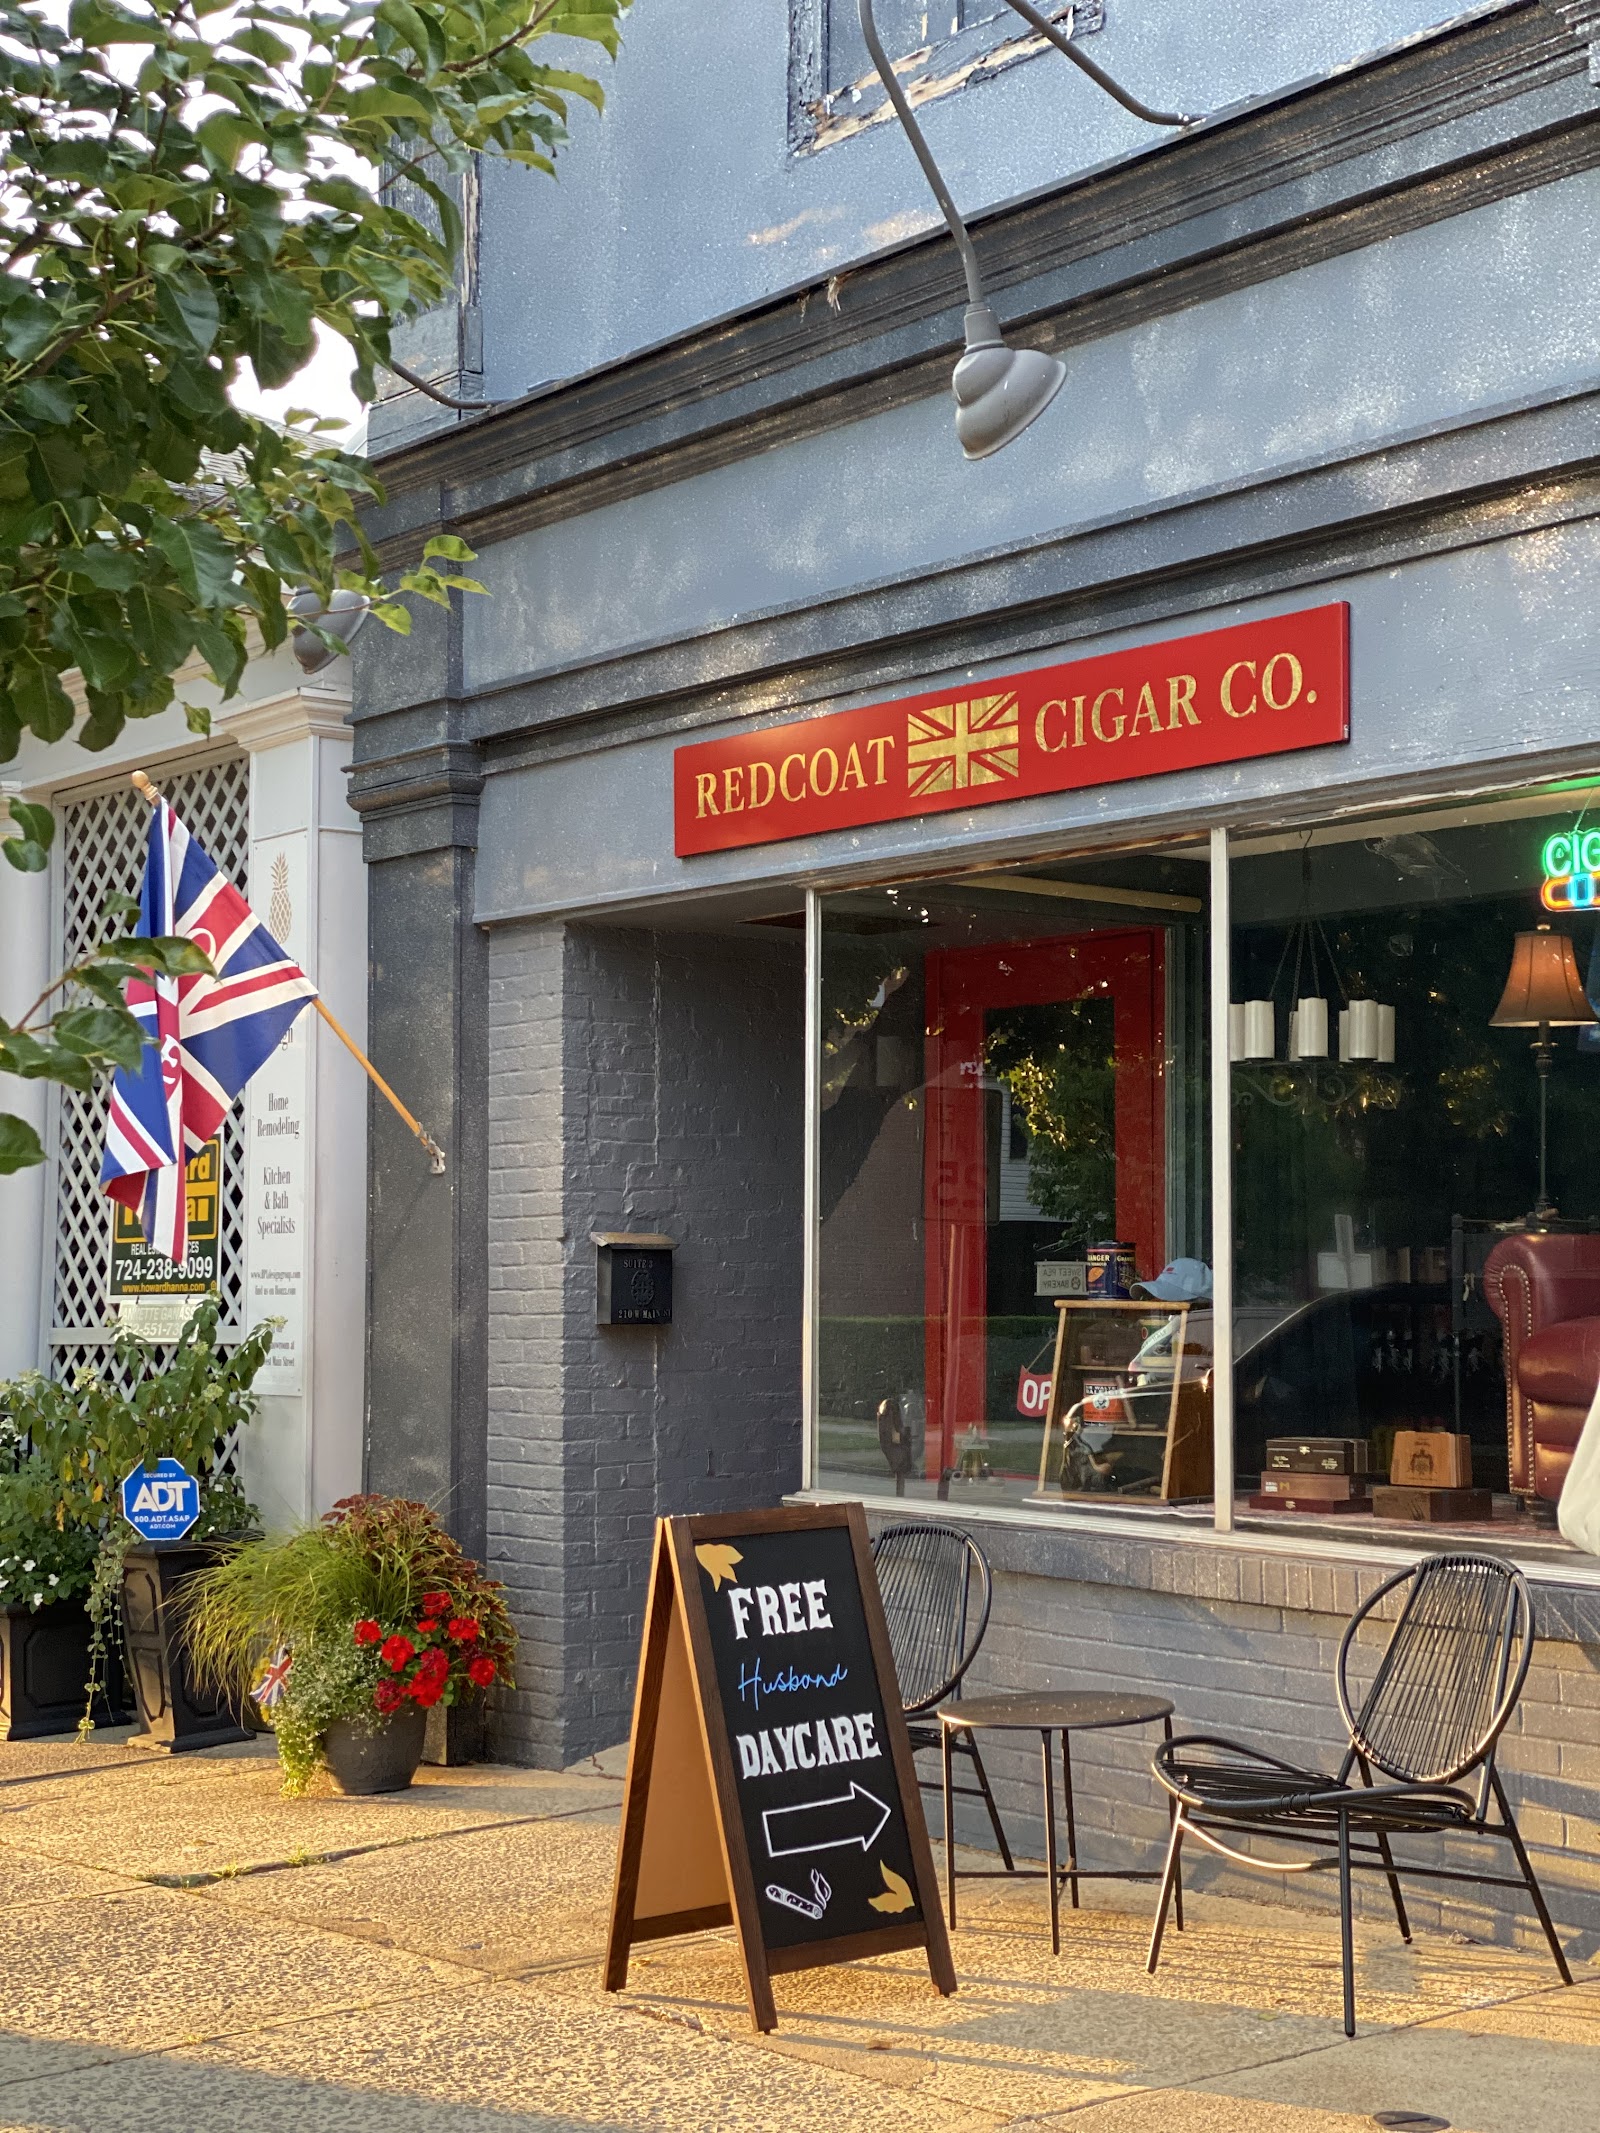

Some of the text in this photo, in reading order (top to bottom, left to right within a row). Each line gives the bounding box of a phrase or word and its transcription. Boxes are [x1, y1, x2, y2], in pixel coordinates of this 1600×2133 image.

[695, 652, 1318, 819] REDCOAT CIGAR CO.
[1545, 832, 1600, 876] CIG
[268, 1093, 288, 1111] Home
[257, 1117, 299, 1139] Remodeling
[263, 1166, 291, 1185] Kitchen
[264, 1191, 288, 1210] & Bath
[257, 1216, 295, 1240] Specialists
[130, 1243, 146, 1256] REAL
[115, 1256, 213, 1281] 724-238-9099
[623, 1259, 647, 1268] SUITE
[121, 1281, 205, 1293] www.howardhanna.com
[161, 1306, 194, 1321] GANASS
[618, 1309, 633, 1319] 210
[1022, 1379, 1052, 1410] OP
[132, 1481, 190, 1512] ADT
[728, 1578, 833, 1640] FREE
[738, 1657, 848, 1710] Husband
[736, 1712, 882, 1780] DAYCARE
